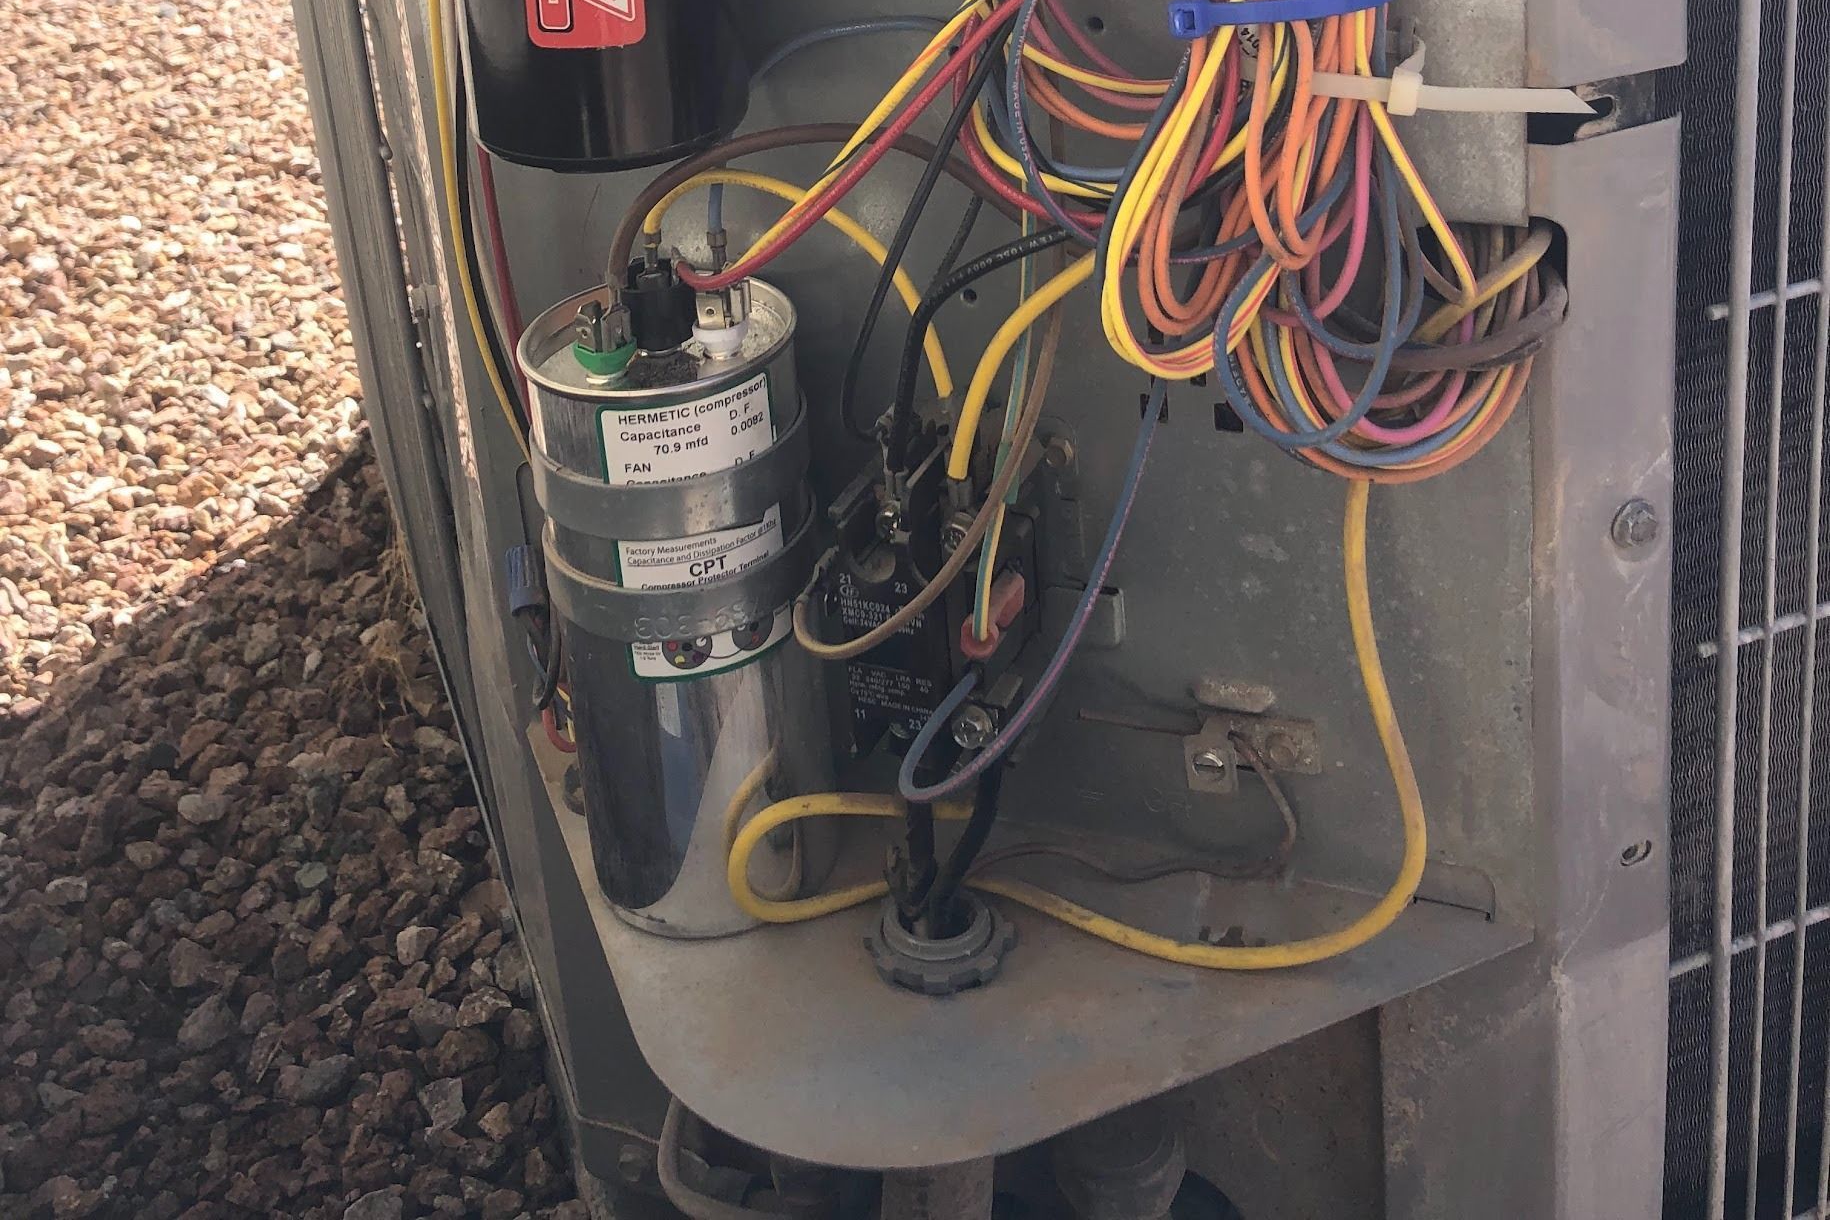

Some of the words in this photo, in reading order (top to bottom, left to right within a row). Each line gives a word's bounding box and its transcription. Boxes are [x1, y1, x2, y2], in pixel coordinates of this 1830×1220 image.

[618, 407, 690, 426] HERMETIC
[694, 376, 767, 418] (compressor)
[620, 423, 701, 443] Capacitance
[653, 443, 682, 456] 70.9
[685, 436, 709, 451] mfd
[730, 411, 764, 436] 0.0082
[624, 463, 652, 474] FAN
[625, 546, 656, 557] Factory
[657, 537, 717, 555] Measurements
[627, 555, 675, 567] Capacitance
[676, 552, 692, 562] and
[693, 541, 735, 559] Dissipation
[736, 531, 757, 545] Factor
[641, 580, 696, 590] Compressor
[697, 567, 738, 585] Protector
[739, 550, 770, 572] Terminal
[689, 555, 728, 577] CPT
[839, 573, 852, 585] 21
[894, 581, 908, 594] 23
[854, 708, 866, 720] 11
